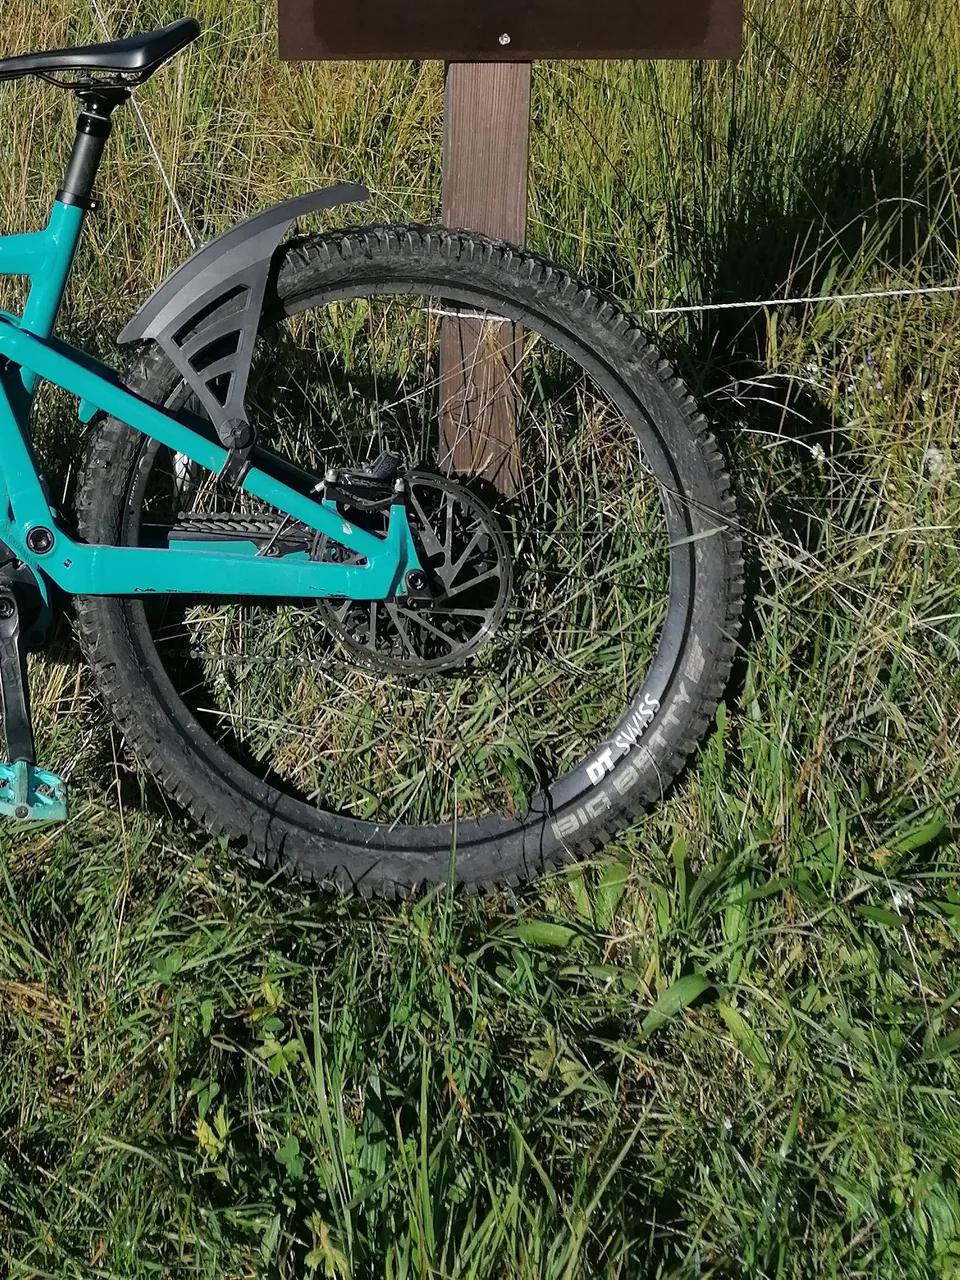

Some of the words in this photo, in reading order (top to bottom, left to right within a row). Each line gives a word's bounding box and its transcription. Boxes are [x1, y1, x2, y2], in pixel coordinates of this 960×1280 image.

[585, 747, 616, 786] DT
[615, 692, 661, 756] SWISS
[551, 790, 612, 840] BIG
